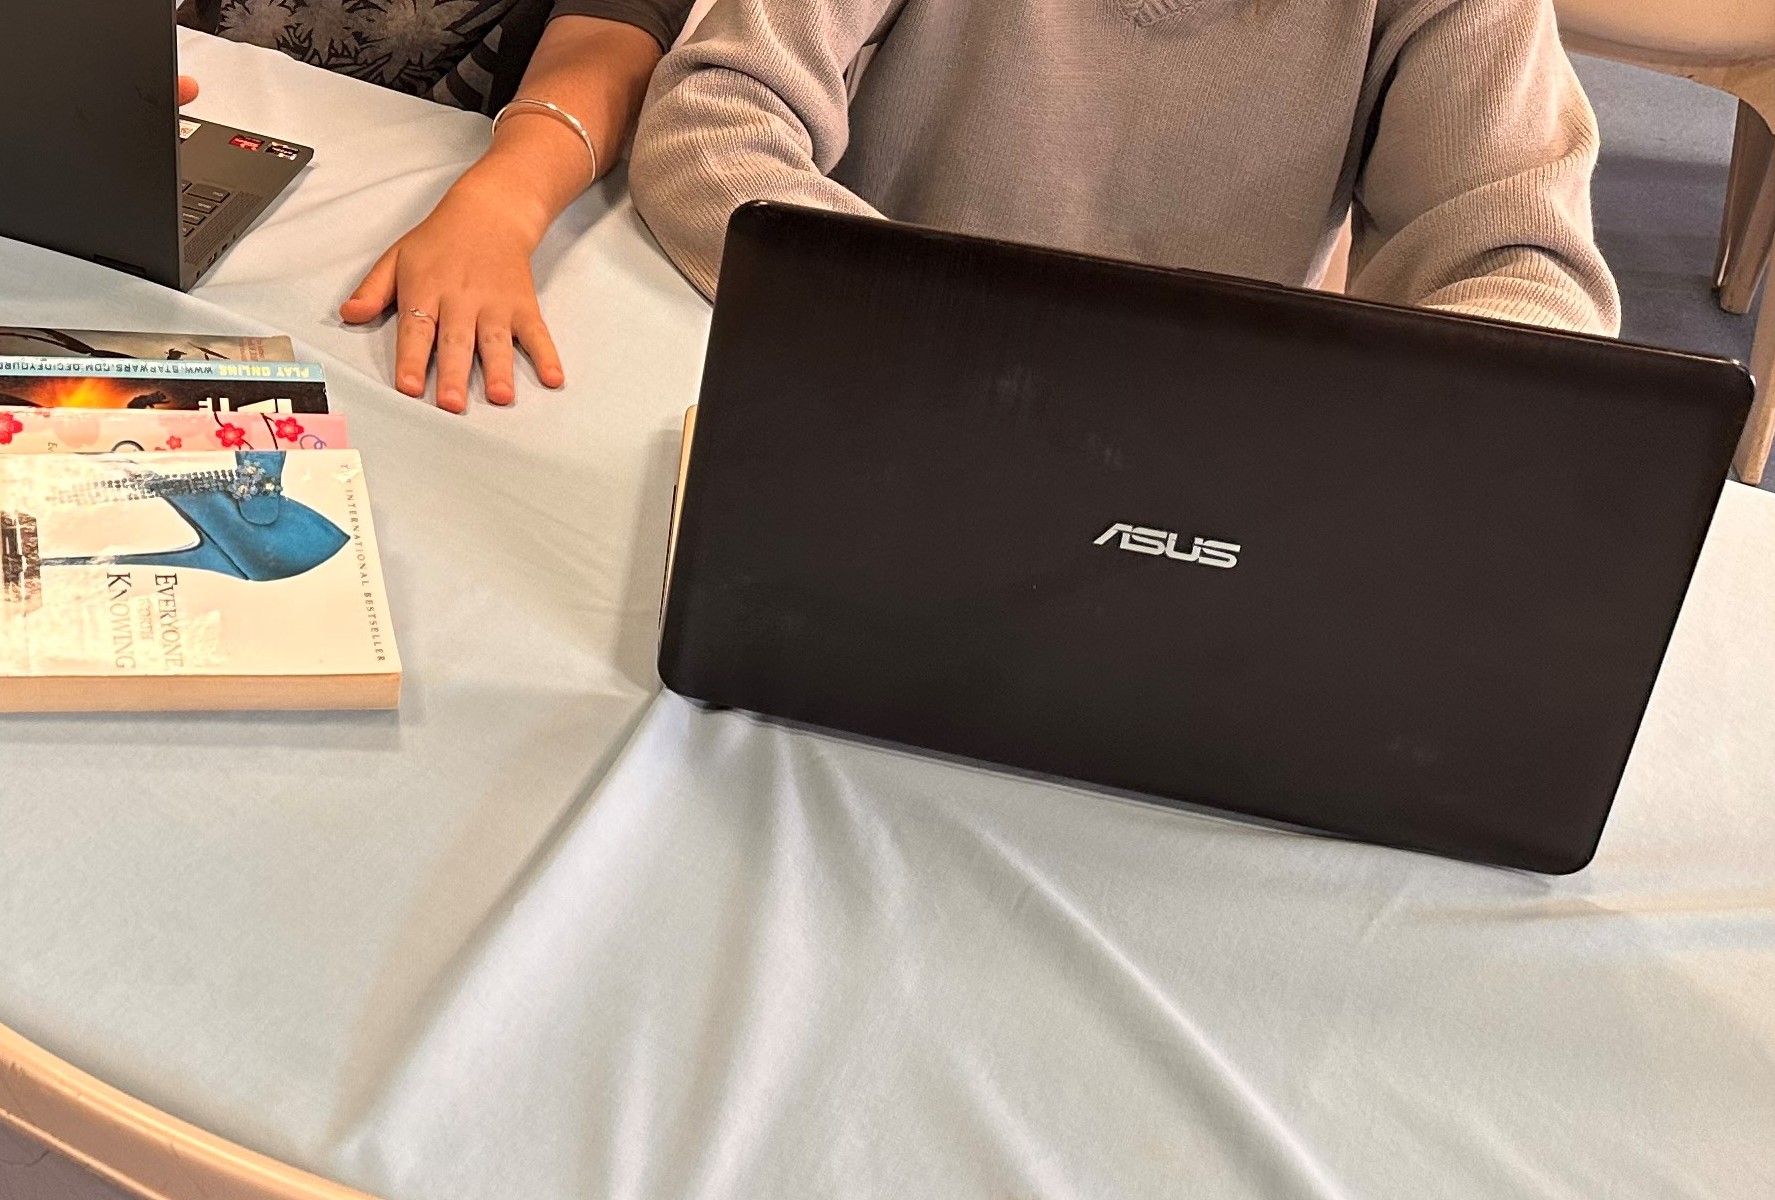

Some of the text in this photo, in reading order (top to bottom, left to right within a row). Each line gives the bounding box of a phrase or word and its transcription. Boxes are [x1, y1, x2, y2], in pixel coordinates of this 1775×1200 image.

[276, 366, 310, 379] PLAY
[346, 489, 369, 587] INTERNATIONAL
[364, 591, 385, 663] BESTSELLER
[1092, 522, 1242, 569] ASUS
[107, 572, 135, 669] KNOWING
[155, 572, 184, 668] EVERYONE
